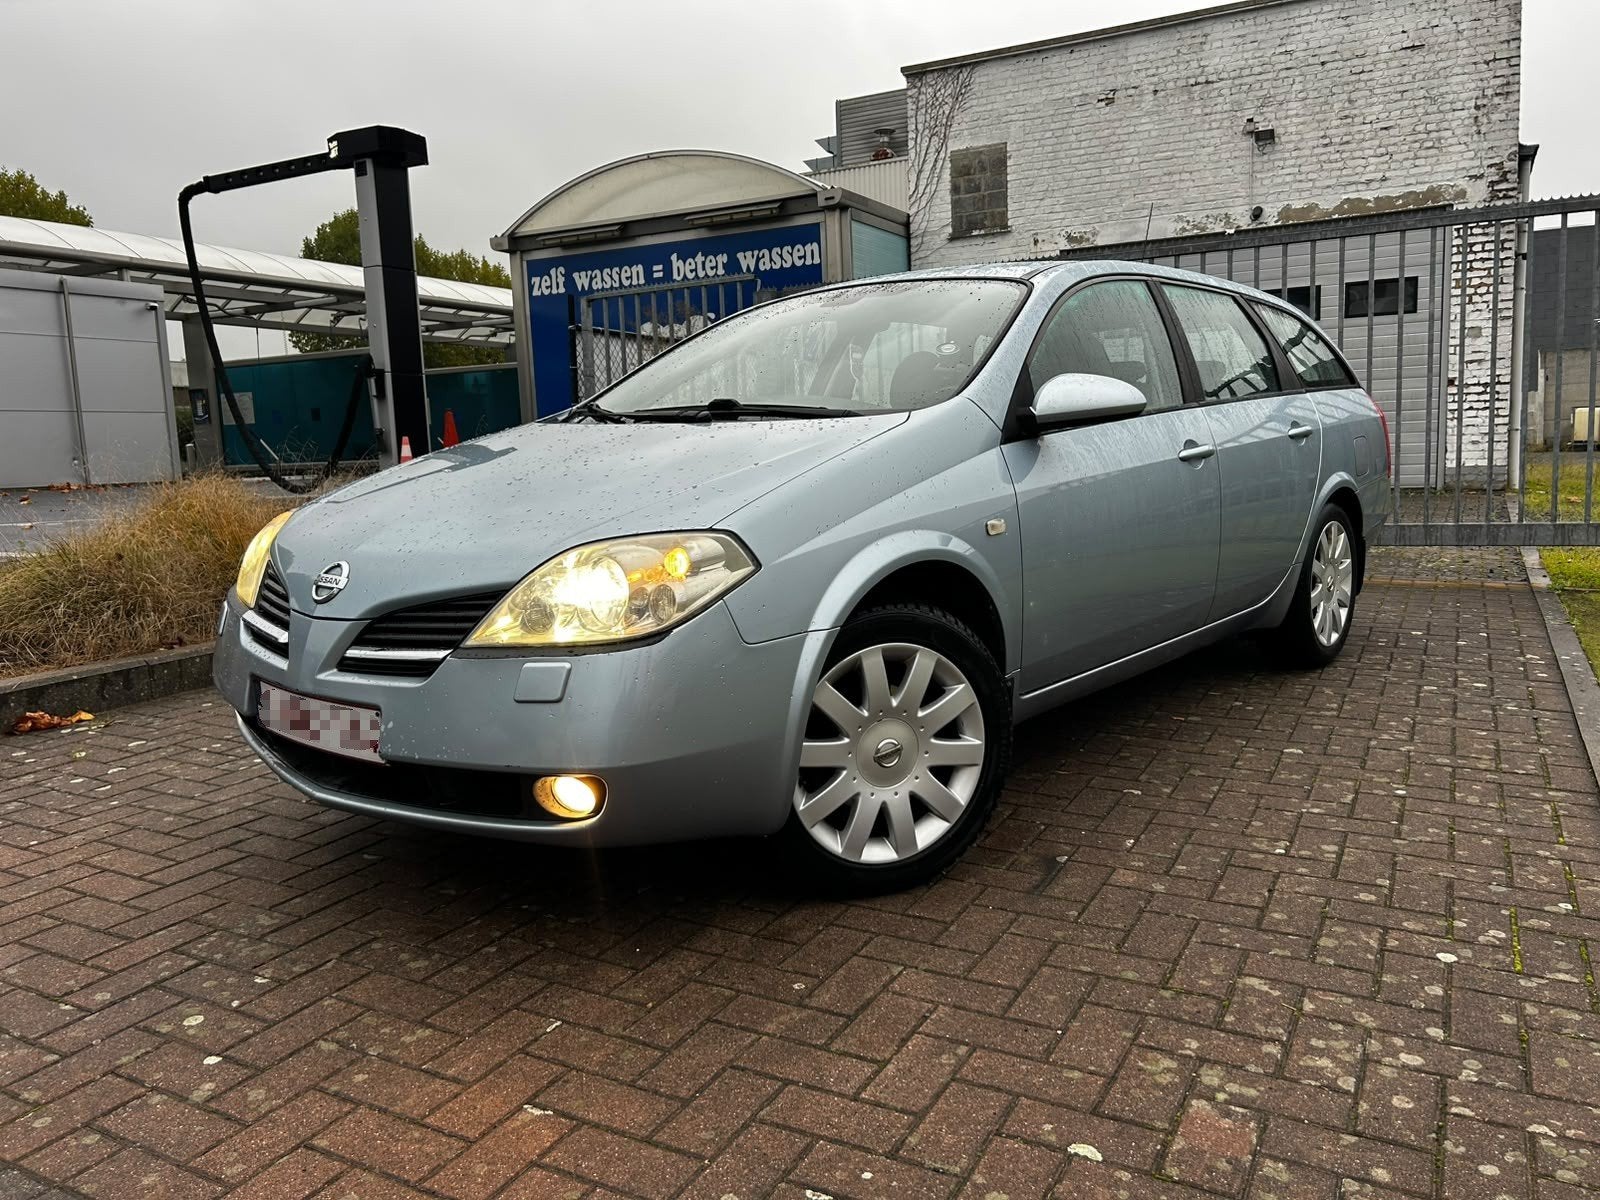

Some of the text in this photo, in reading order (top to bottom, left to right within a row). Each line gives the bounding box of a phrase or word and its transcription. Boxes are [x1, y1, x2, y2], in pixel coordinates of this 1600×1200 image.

[531, 241, 821, 296] zelf wassen = beter wassen
